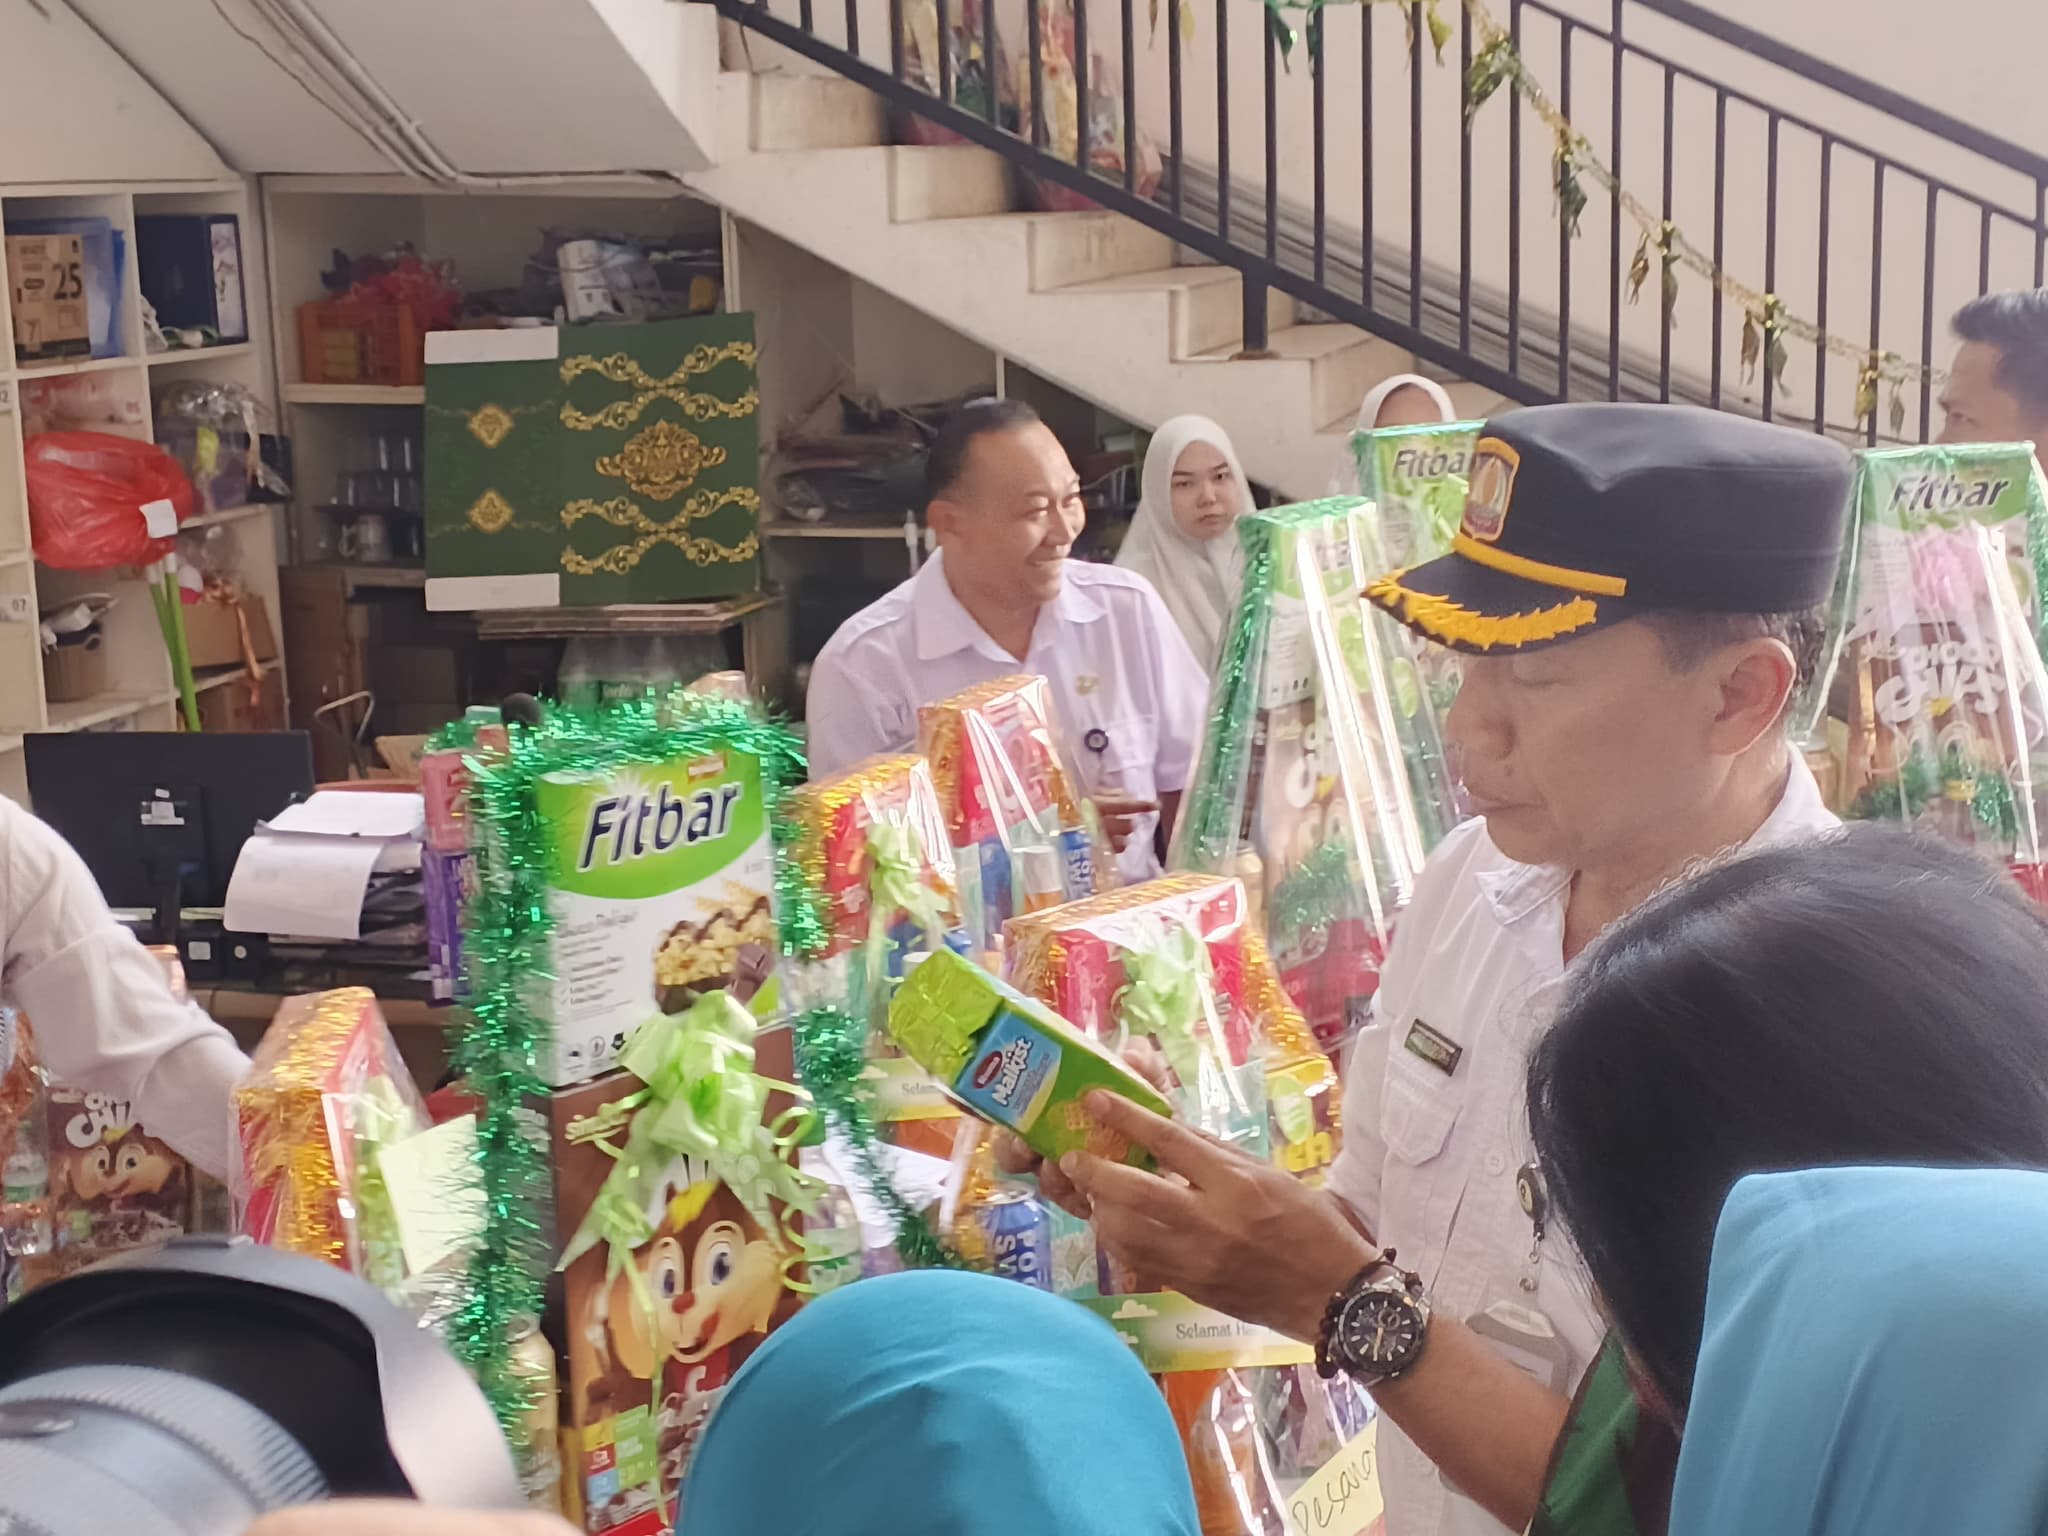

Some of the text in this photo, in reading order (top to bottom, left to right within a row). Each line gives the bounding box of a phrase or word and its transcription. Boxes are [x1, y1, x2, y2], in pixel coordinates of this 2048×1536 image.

[52, 261, 84, 300] 25
[1888, 474, 2010, 512] Fitbar
[577, 781, 743, 872] Fitbar
[989, 1034, 1033, 1108] Malkist
[1175, 1321, 1232, 1340] Selamat
